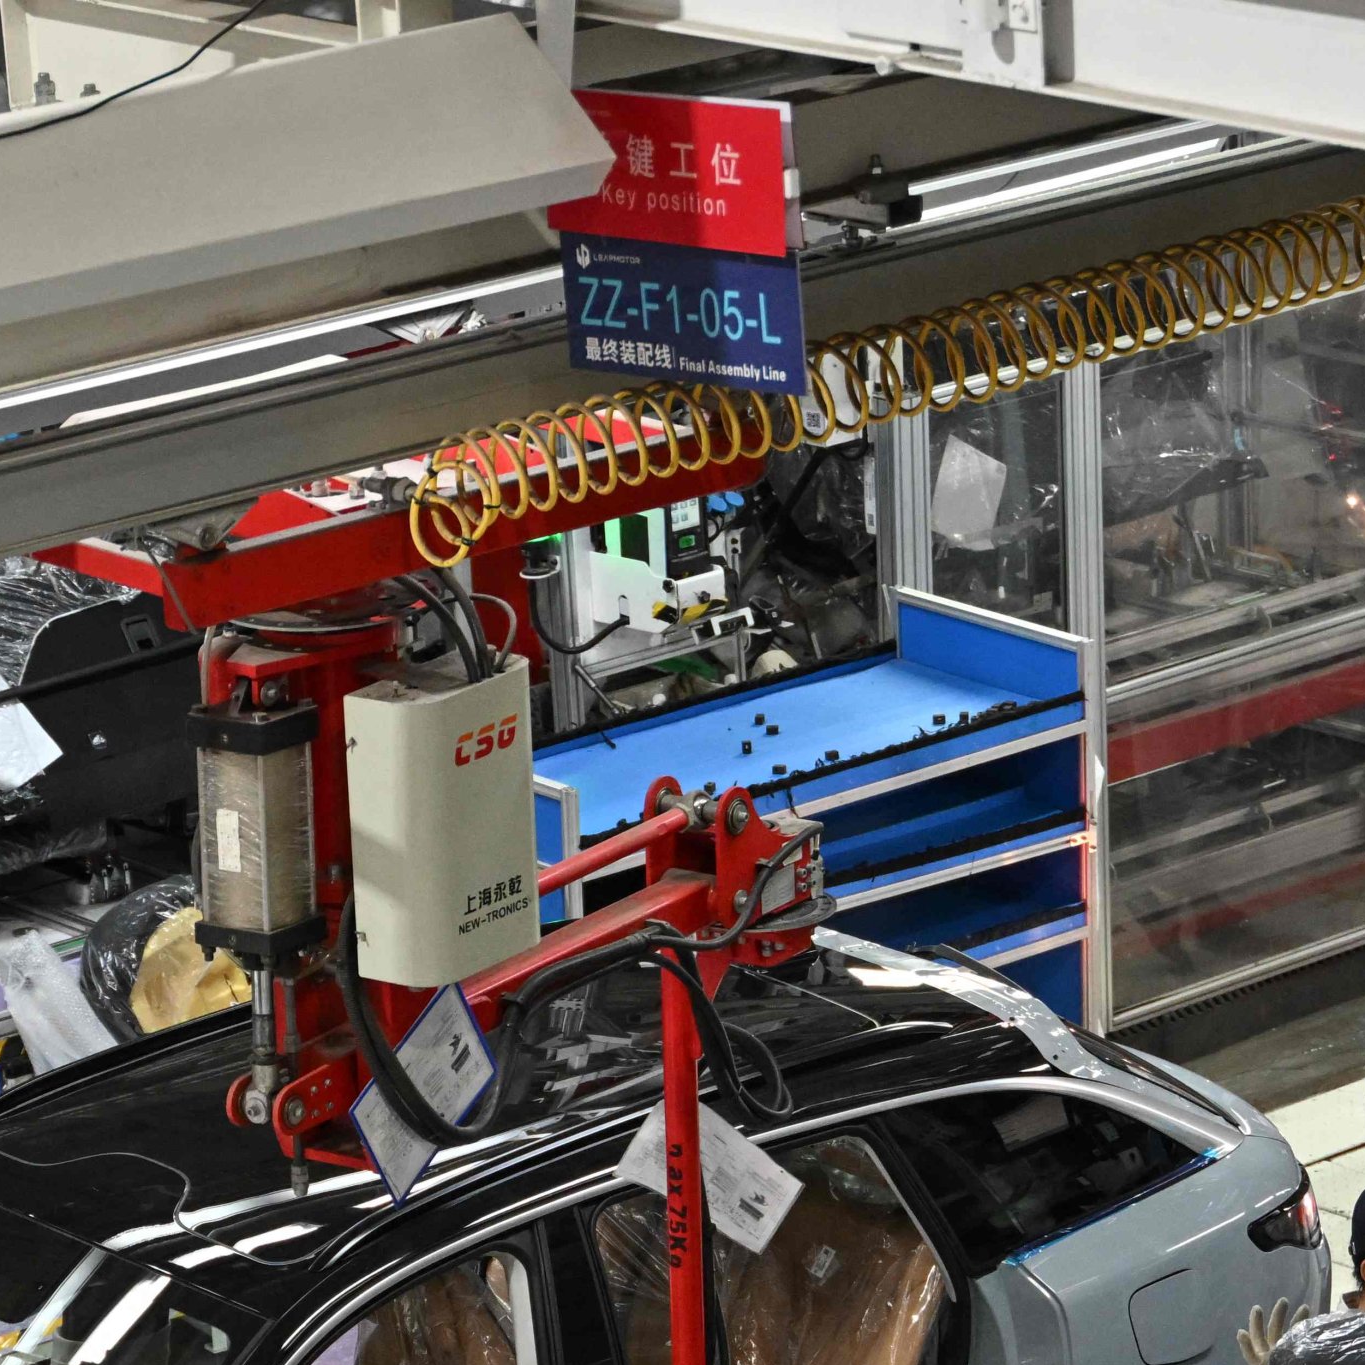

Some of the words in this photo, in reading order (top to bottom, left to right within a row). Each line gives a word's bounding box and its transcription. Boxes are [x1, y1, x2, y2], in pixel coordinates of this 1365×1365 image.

[603, 131, 742, 187] 键工位
[602, 184, 637, 211] Key
[647, 189, 727, 217] position
[592, 252, 642, 266] LEAPMOTOR
[578, 276, 782, 345] ZZ-F1-05-L
[585, 336, 673, 370] 最终装配线
[679, 356, 706, 374] Final
[708, 359, 760, 382] Assembly
[762, 365, 787, 382] Line
[454, 712, 519, 767] CSG
[458, 897, 529, 936] NEW-TRONICS
[463, 874, 523, 916] 上海永乾
